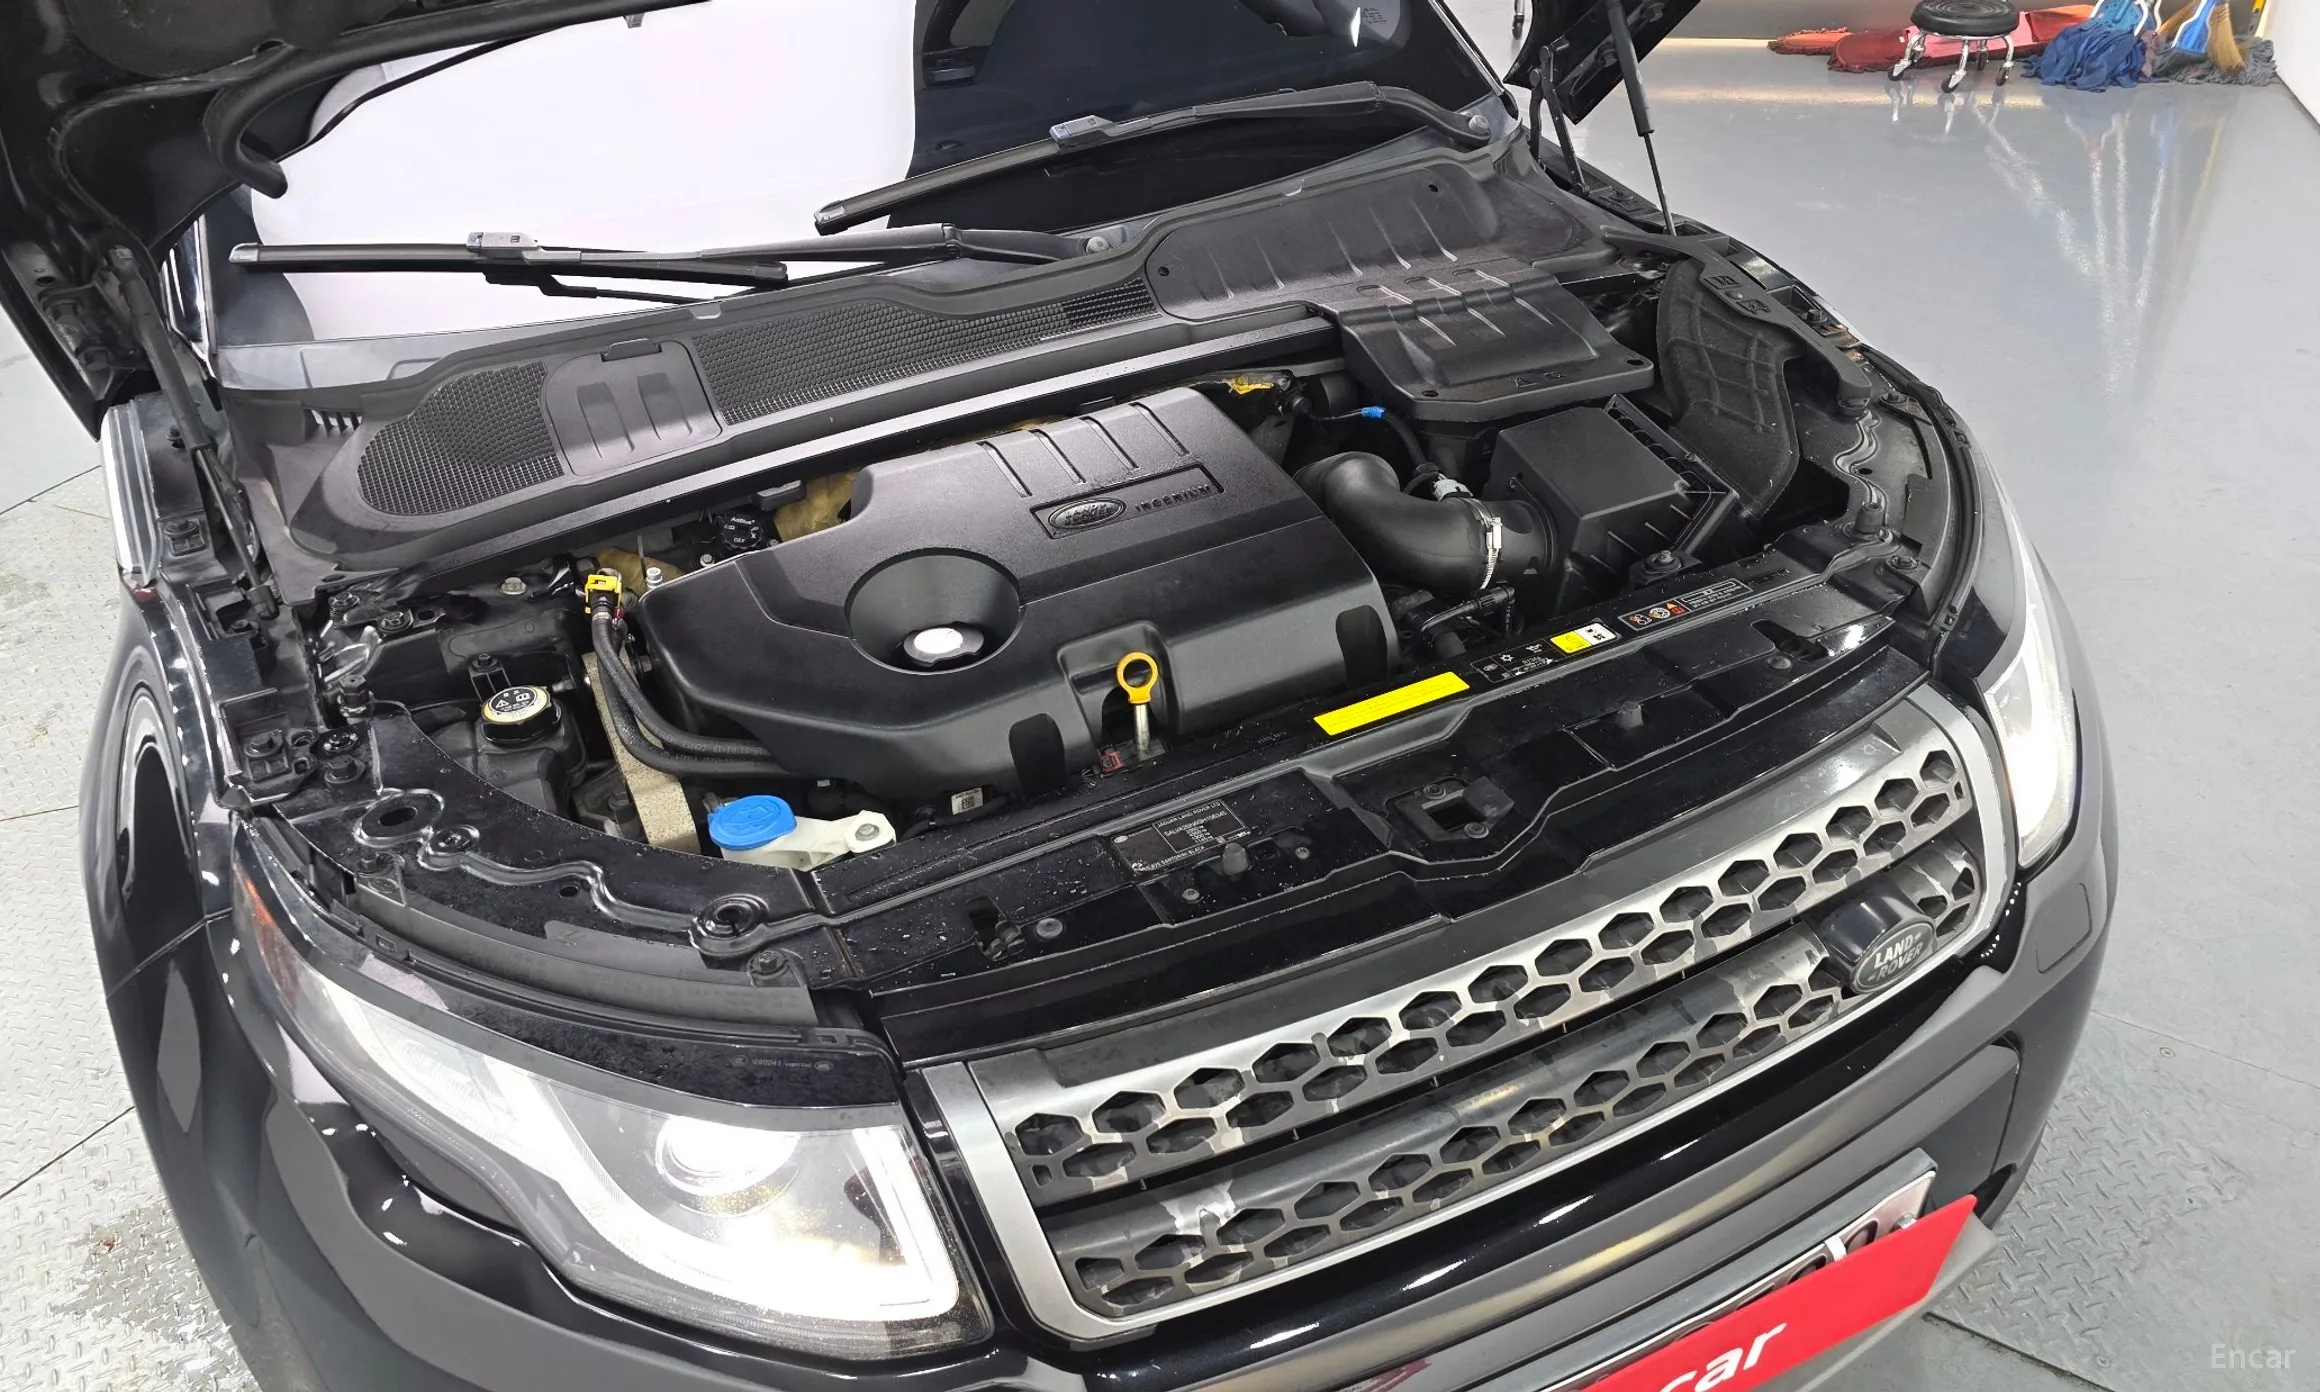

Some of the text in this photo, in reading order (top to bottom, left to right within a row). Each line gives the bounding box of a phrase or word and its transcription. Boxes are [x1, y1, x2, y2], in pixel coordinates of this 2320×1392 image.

[1135, 484, 1212, 512] INGENIUM
[1874, 934, 1915, 969] LAND
[1877, 941, 1924, 981] ROVER
